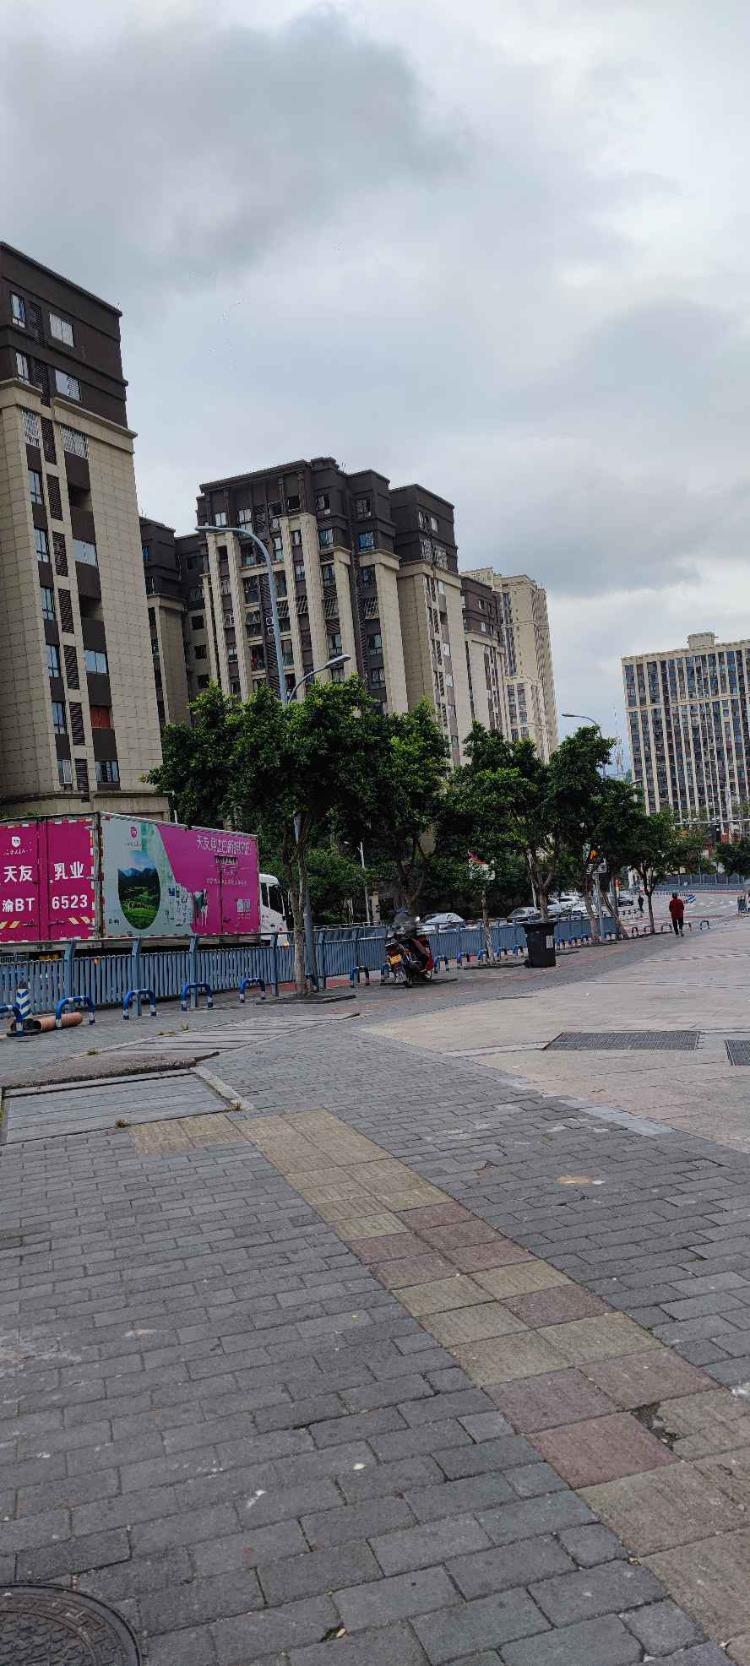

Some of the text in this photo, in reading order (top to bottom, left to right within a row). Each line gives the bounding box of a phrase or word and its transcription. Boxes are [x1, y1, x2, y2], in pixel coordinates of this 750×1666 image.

[3, 861, 85, 883] 天友 乳业
[2, 894, 88, 912] 渝BT 6523
